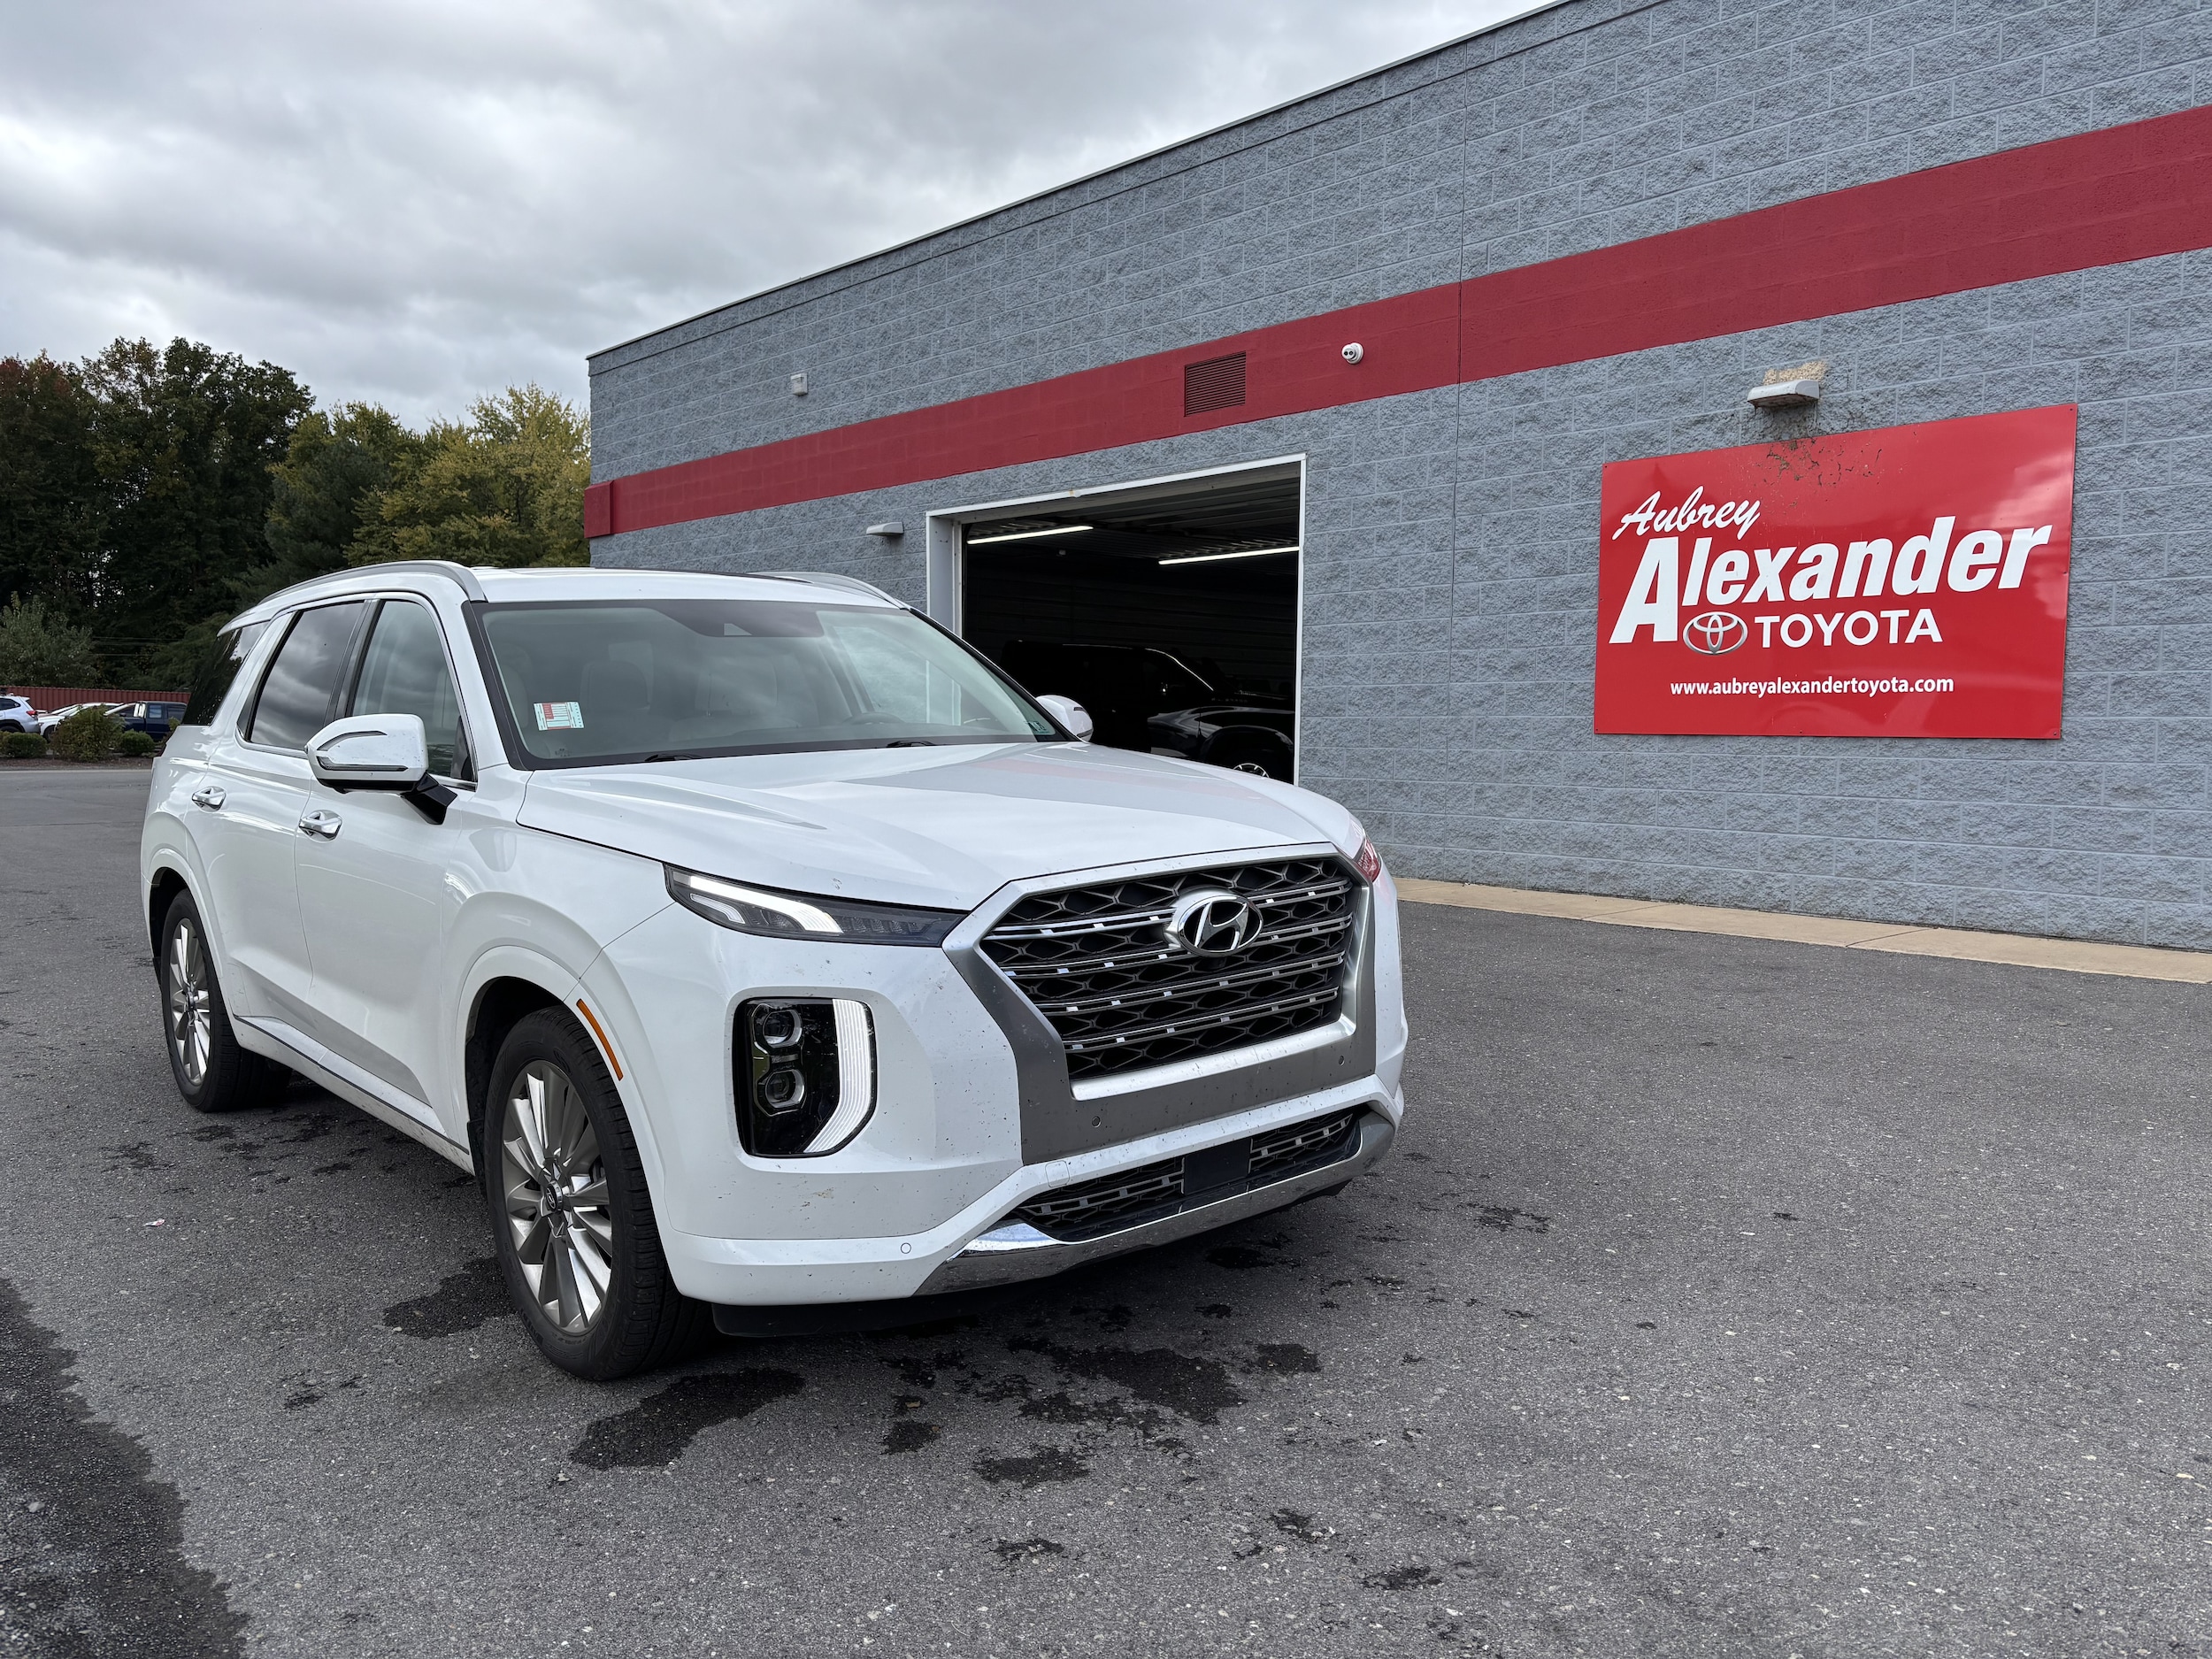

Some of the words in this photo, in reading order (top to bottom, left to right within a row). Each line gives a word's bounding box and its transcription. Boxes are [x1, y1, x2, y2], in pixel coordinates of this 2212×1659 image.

[1612, 486, 1760, 540] Aubrey
[1609, 516, 2052, 644] Alexander
[1755, 609, 1943, 648] TOYOTA
[1671, 676, 1955, 698] www.aubreyalexandertoyota.com
